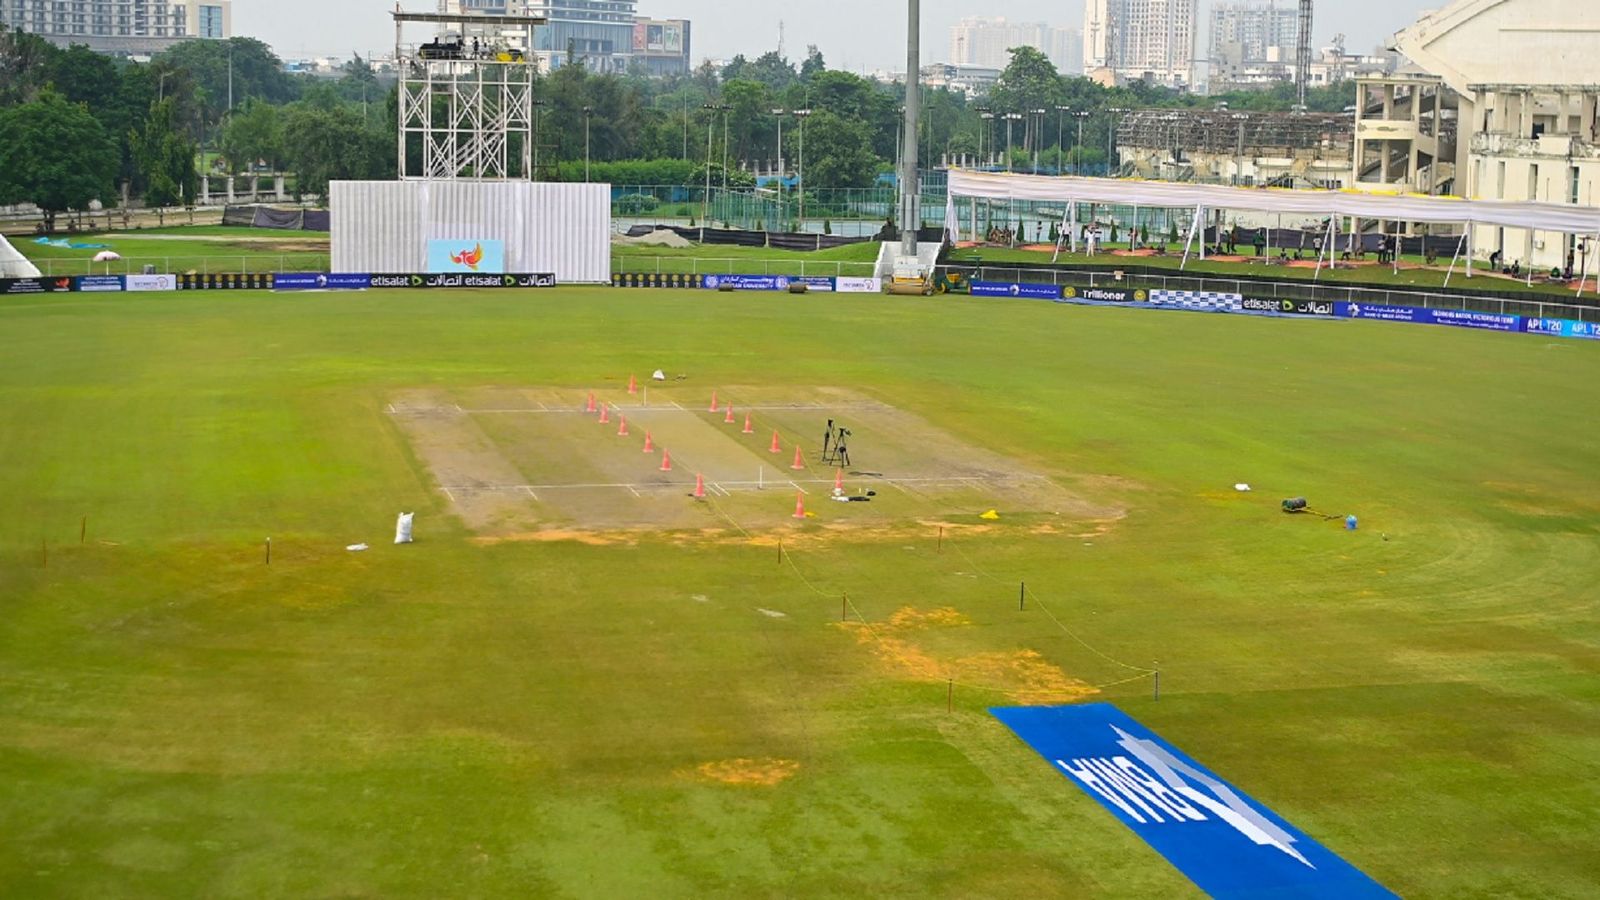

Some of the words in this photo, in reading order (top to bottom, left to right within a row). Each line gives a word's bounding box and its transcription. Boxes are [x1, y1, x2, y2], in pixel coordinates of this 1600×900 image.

[370, 275, 410, 287] etisalat
[426, 274, 462, 287] اتصالات
[464, 274, 502, 286] etisalat
[518, 274, 555, 286] اتصالات
[1082, 289, 1126, 301] Trillioner
[1243, 298, 1280, 310] etisalat
[1297, 301, 1333, 314] اتصالات
[1527, 318, 1543, 330] APL
[1546, 319, 1562, 331] T20
[1572, 322, 1588, 334] APL
[1056, 755, 1208, 824] BMA
